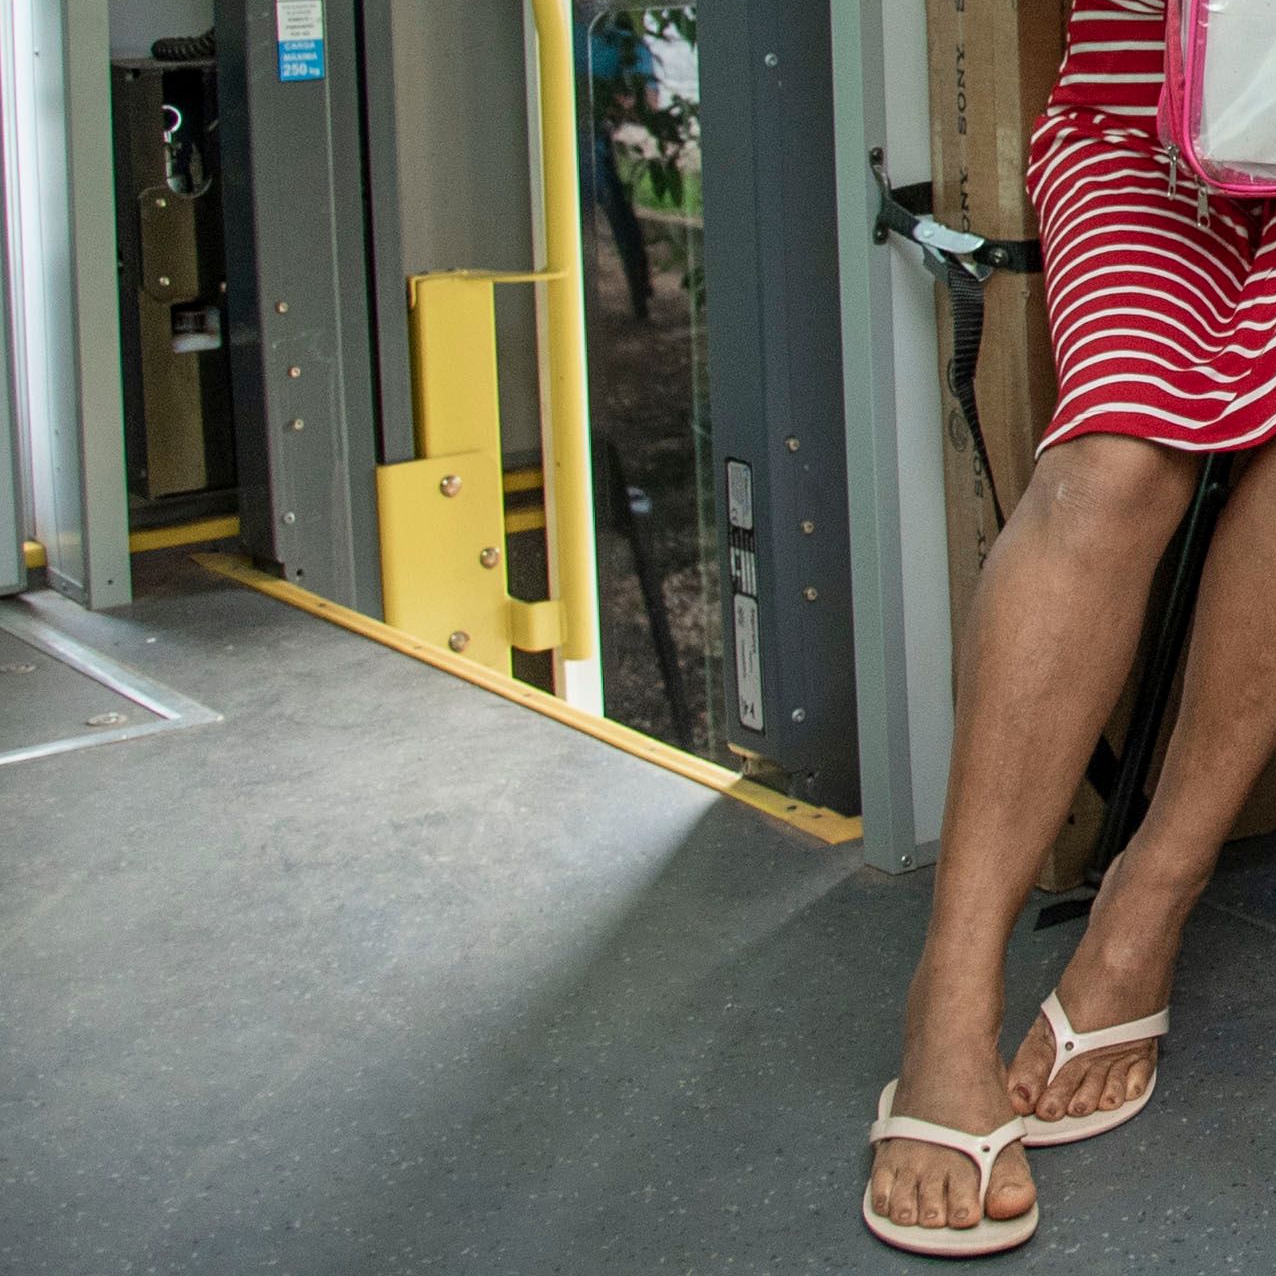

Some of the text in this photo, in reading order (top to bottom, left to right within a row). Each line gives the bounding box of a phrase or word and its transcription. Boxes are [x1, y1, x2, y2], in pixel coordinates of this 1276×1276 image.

[283, 62, 308, 77] 250
[956, 43, 967, 136] SONY
[960, 166, 971, 234] ONY
